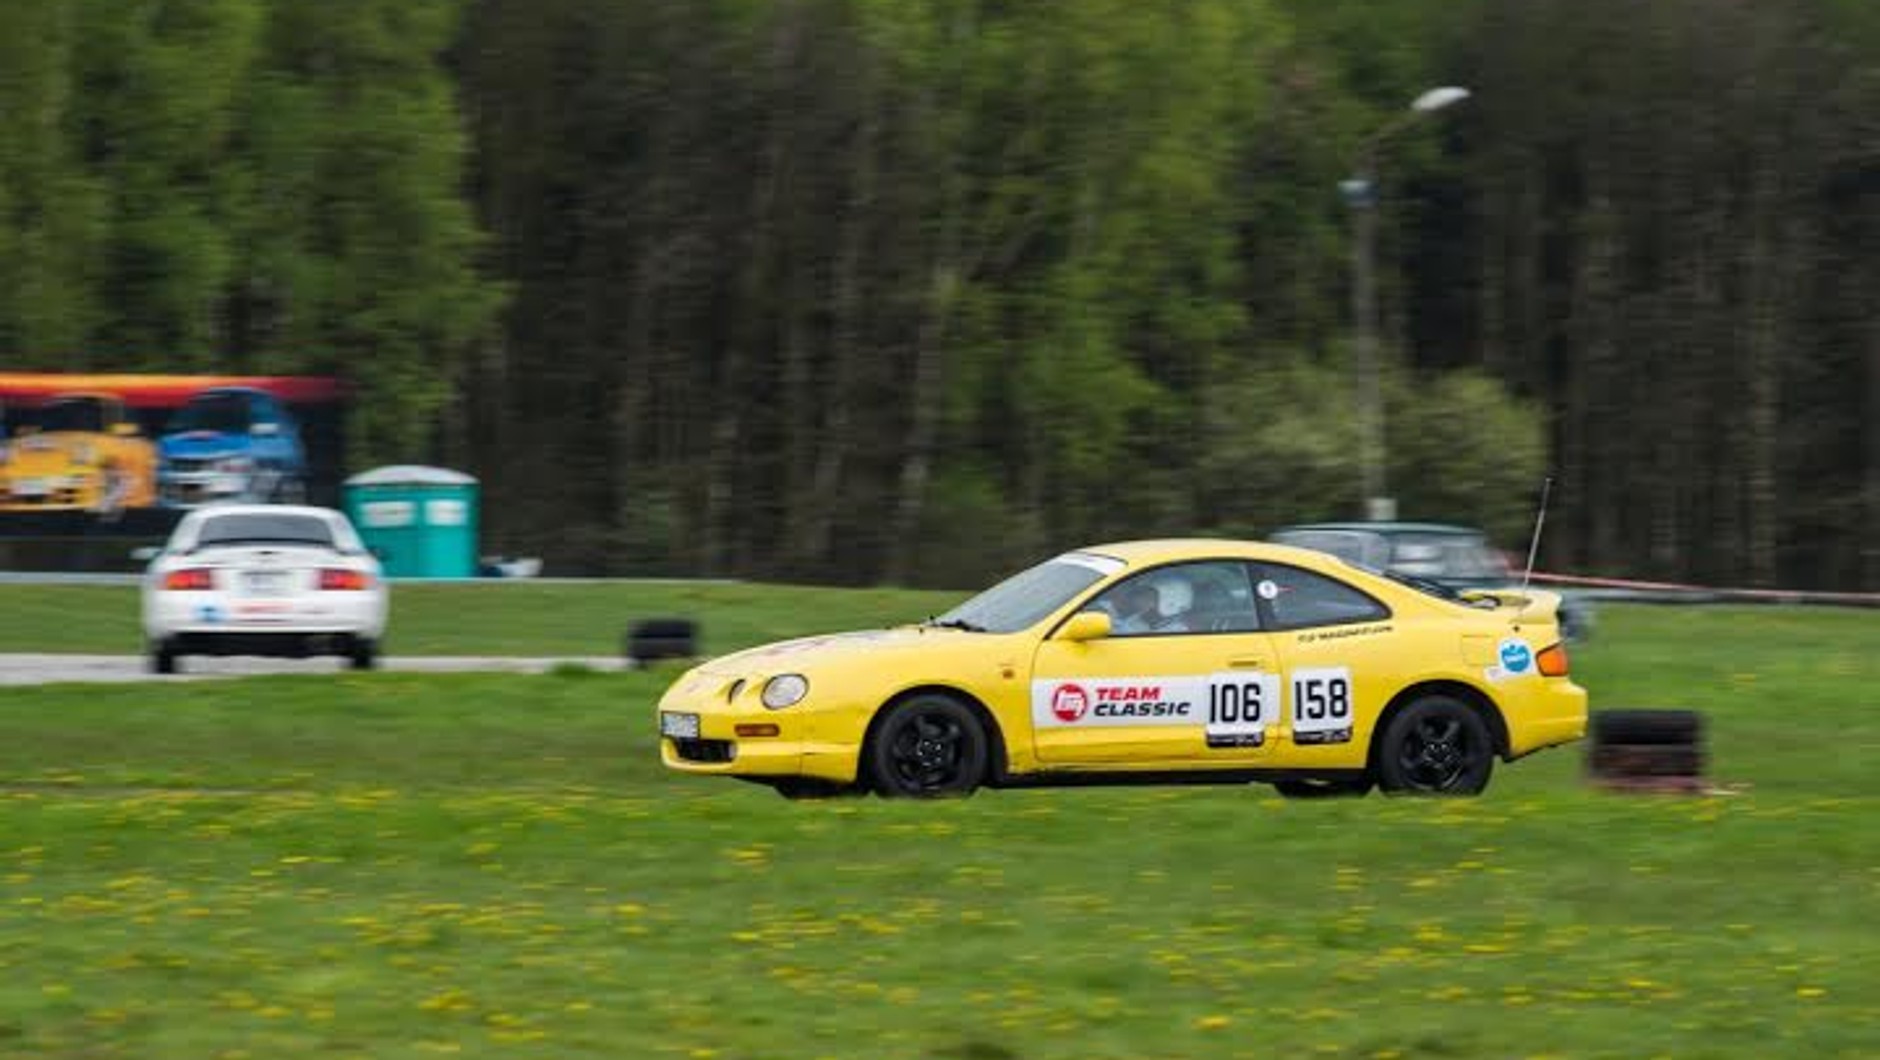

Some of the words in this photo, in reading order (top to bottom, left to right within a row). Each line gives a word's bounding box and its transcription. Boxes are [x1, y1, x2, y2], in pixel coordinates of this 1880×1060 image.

[1095, 687, 1161, 701] TEAM
[1209, 684, 1261, 723] 106
[1295, 679, 1348, 721] 158
[1094, 702, 1191, 717] CLASSIC
